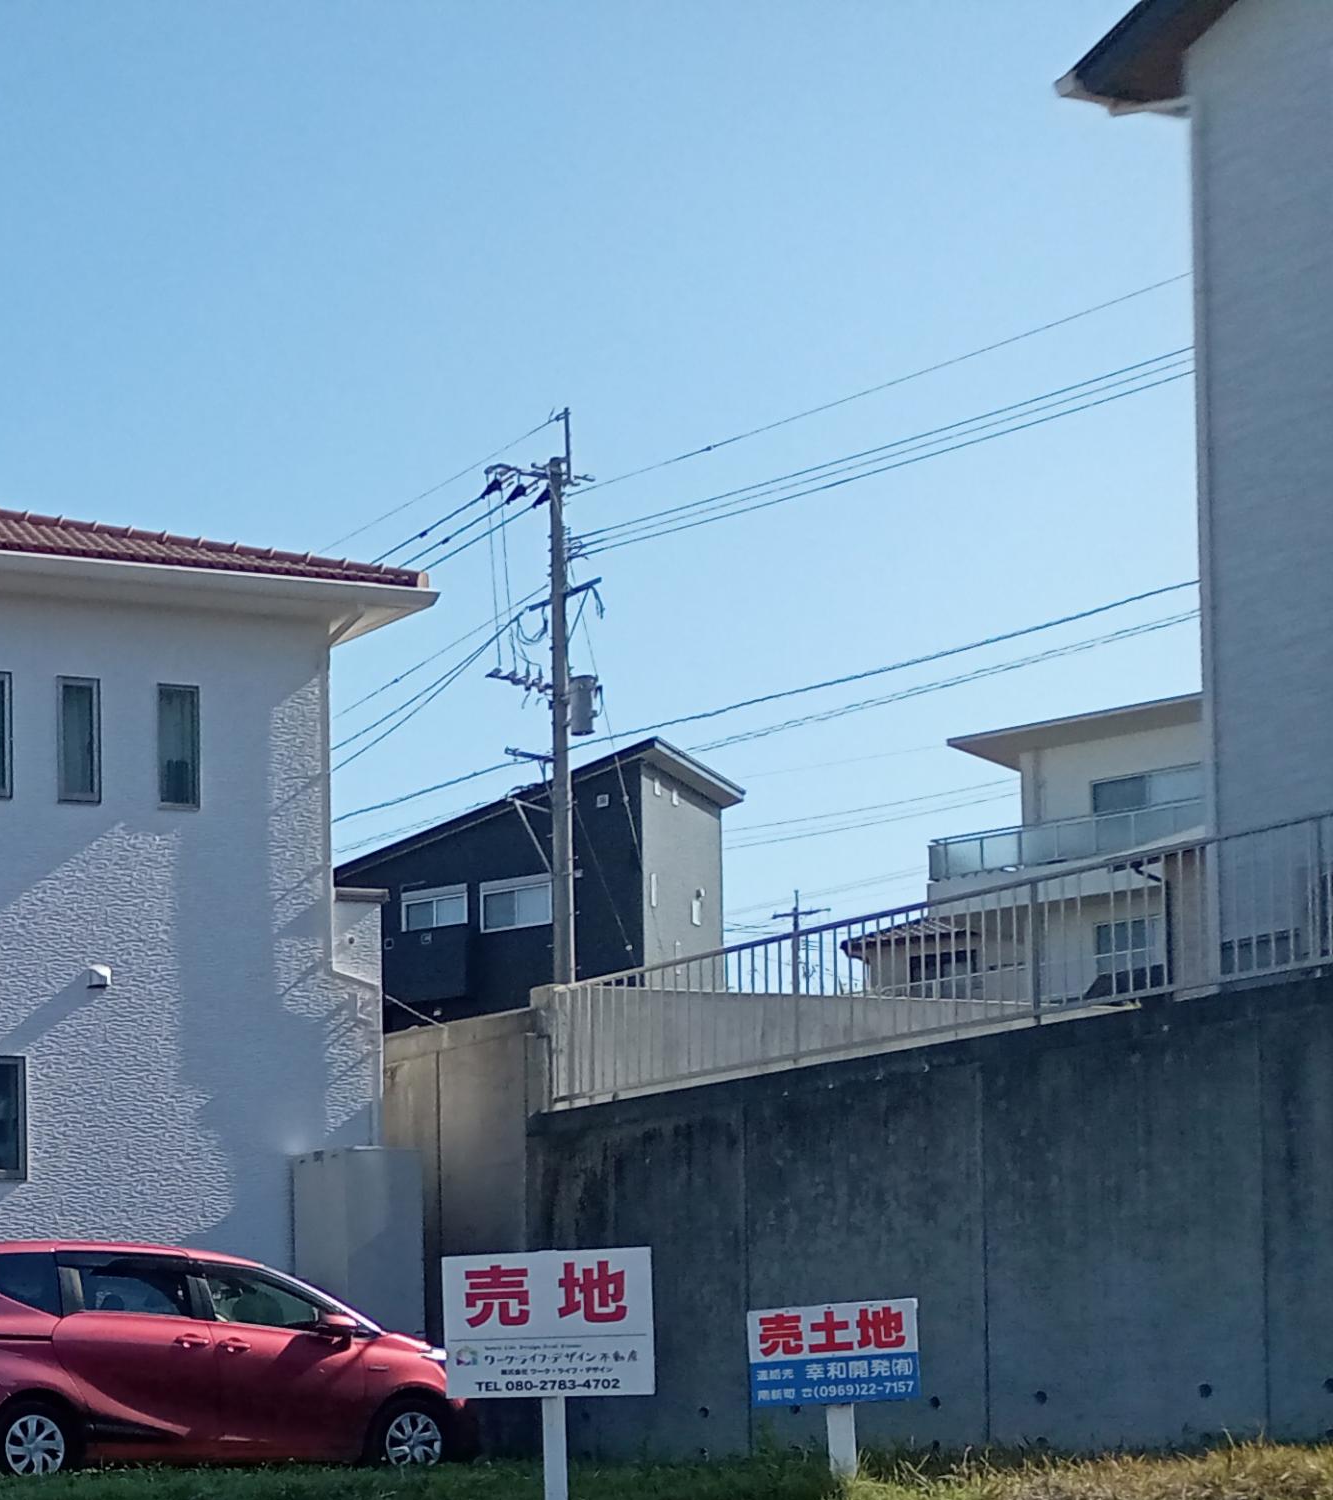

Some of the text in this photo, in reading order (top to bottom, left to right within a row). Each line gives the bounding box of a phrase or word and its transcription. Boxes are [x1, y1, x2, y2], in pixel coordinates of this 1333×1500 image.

[464, 1260, 628, 1328] 売地
[759, 1306, 906, 1357] 売土地
[475, 1378, 621, 1392] TEL 080-2783-4702
[814, 1381, 915, 1399] (0969)22-7157
